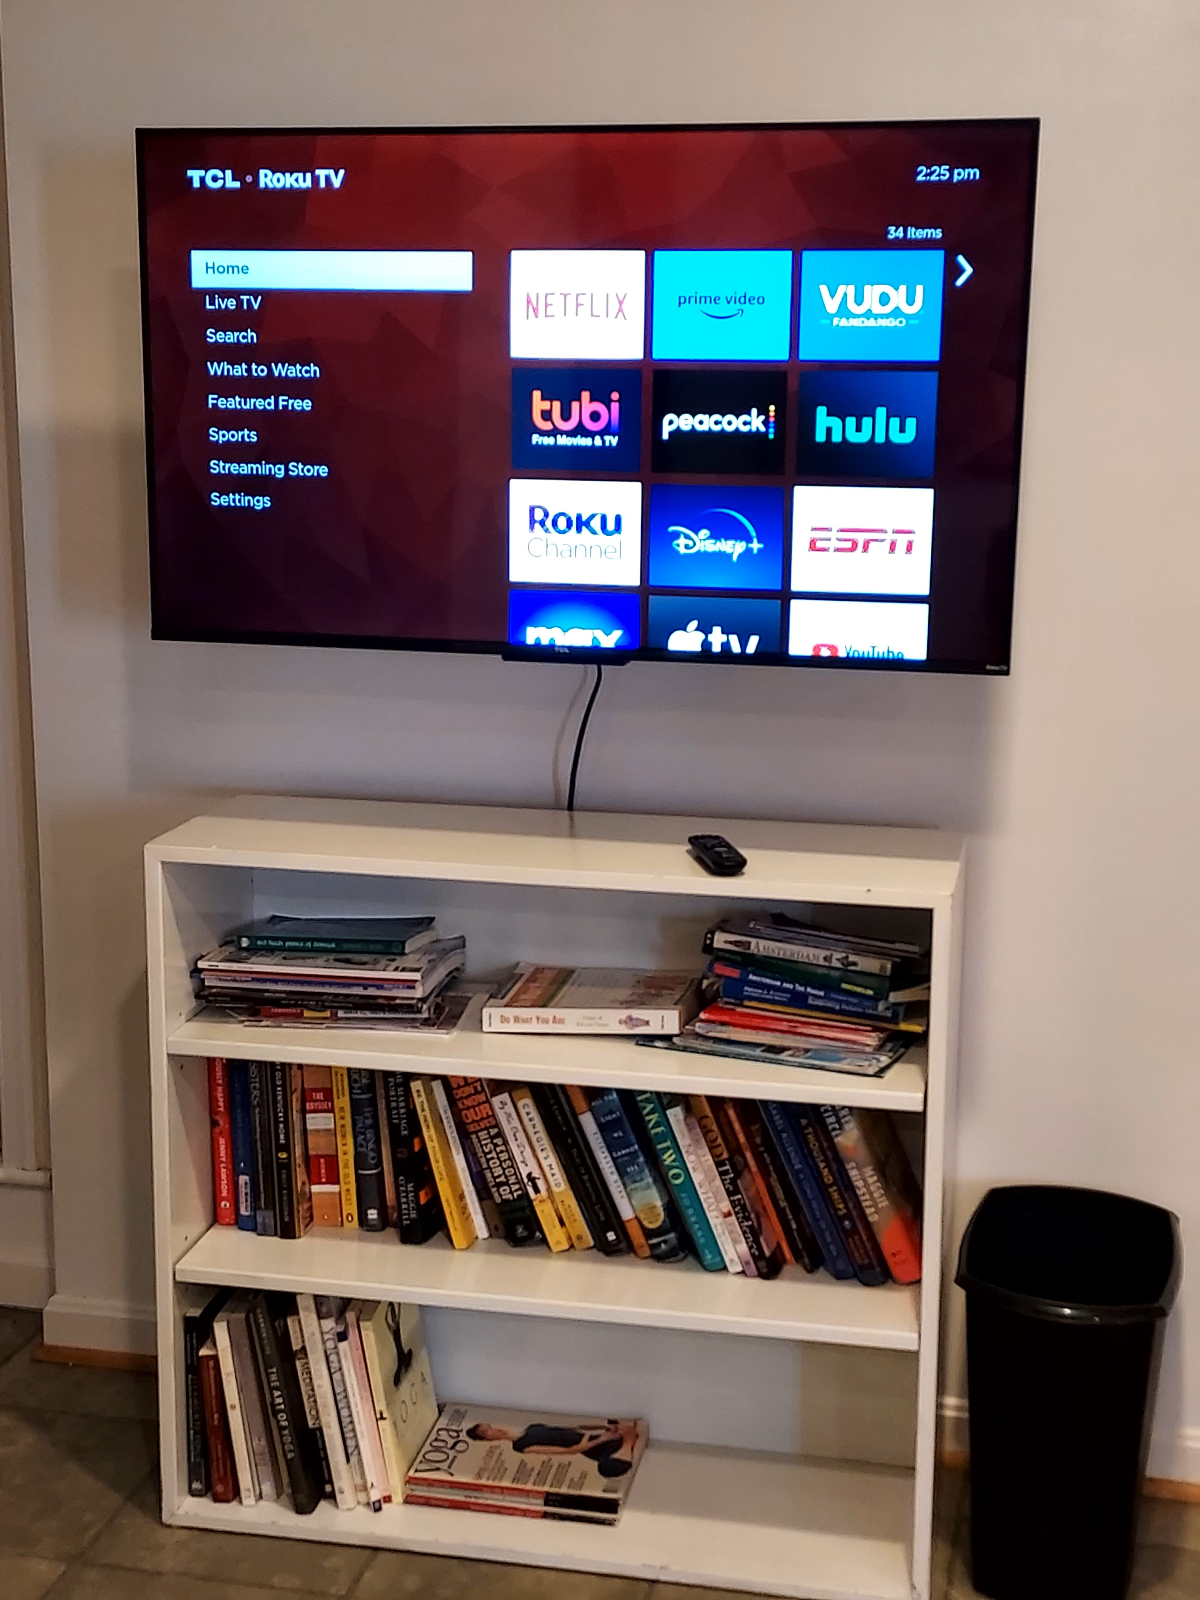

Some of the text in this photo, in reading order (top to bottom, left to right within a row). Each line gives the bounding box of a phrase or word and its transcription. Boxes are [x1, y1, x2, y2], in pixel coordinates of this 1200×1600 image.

[187, 168, 345, 189] TCL Roku TV
[916, 165, 980, 183] 2:25 pm
[887, 226, 943, 239] 34 Items
[204, 261, 250, 275] Home
[205, 295, 262, 311] Live TV
[526, 292, 627, 320] NETFLIX
[678, 291, 766, 308] prime video
[819, 283, 925, 316] VUDU
[206, 328, 257, 344] Search
[832, 317, 906, 328] FANDANGO
[207, 361, 320, 378] What to Watch
[208, 394, 312, 411] Featured Free
[531, 389, 620, 432] tubi
[209, 427, 258, 444] Sports
[662, 407, 766, 441] peacock
[815, 406, 917, 444] hulu
[531, 433, 555, 446] Free
[556, 434, 593, 447] Movies
[603, 435, 619, 447] TV
[209, 460, 329, 478] Streaming Store
[210, 492, 271, 510] Settings
[527, 537, 622, 560] Channel
[808, 526, 916, 555] ESPN
[276, 1087, 284, 1121] KENTUCKY
[312, 1091, 324, 1100] THE
[397, 1087, 408, 1136] MARRIAGE
[461, 1103, 493, 1123] OUR
[634, 1090, 667, 1138] TAKE
[654, 1139, 688, 1187] TWO
[695, 1113, 728, 1160] GOD
[478, 1129, 514, 1203] HISTORY OF
[489, 1127, 524, 1200] A PERSONAL
[546, 1162, 563, 1190] MAID
[716, 1159, 740, 1192] The
[801, 1126, 835, 1186] THOUSAND
[826, 1185, 848, 1217] SHIPS
[220, 1163, 228, 1197] LAWSON
[861, 1164, 890, 1210] MAGGIE
[407, 1182, 417, 1219] MAGGIE
[727, 1193, 766, 1257] Evidence
[299, 1359, 321, 1427] MEDITATION
[267, 1366, 296, 1459] THE ART OF YOGA
